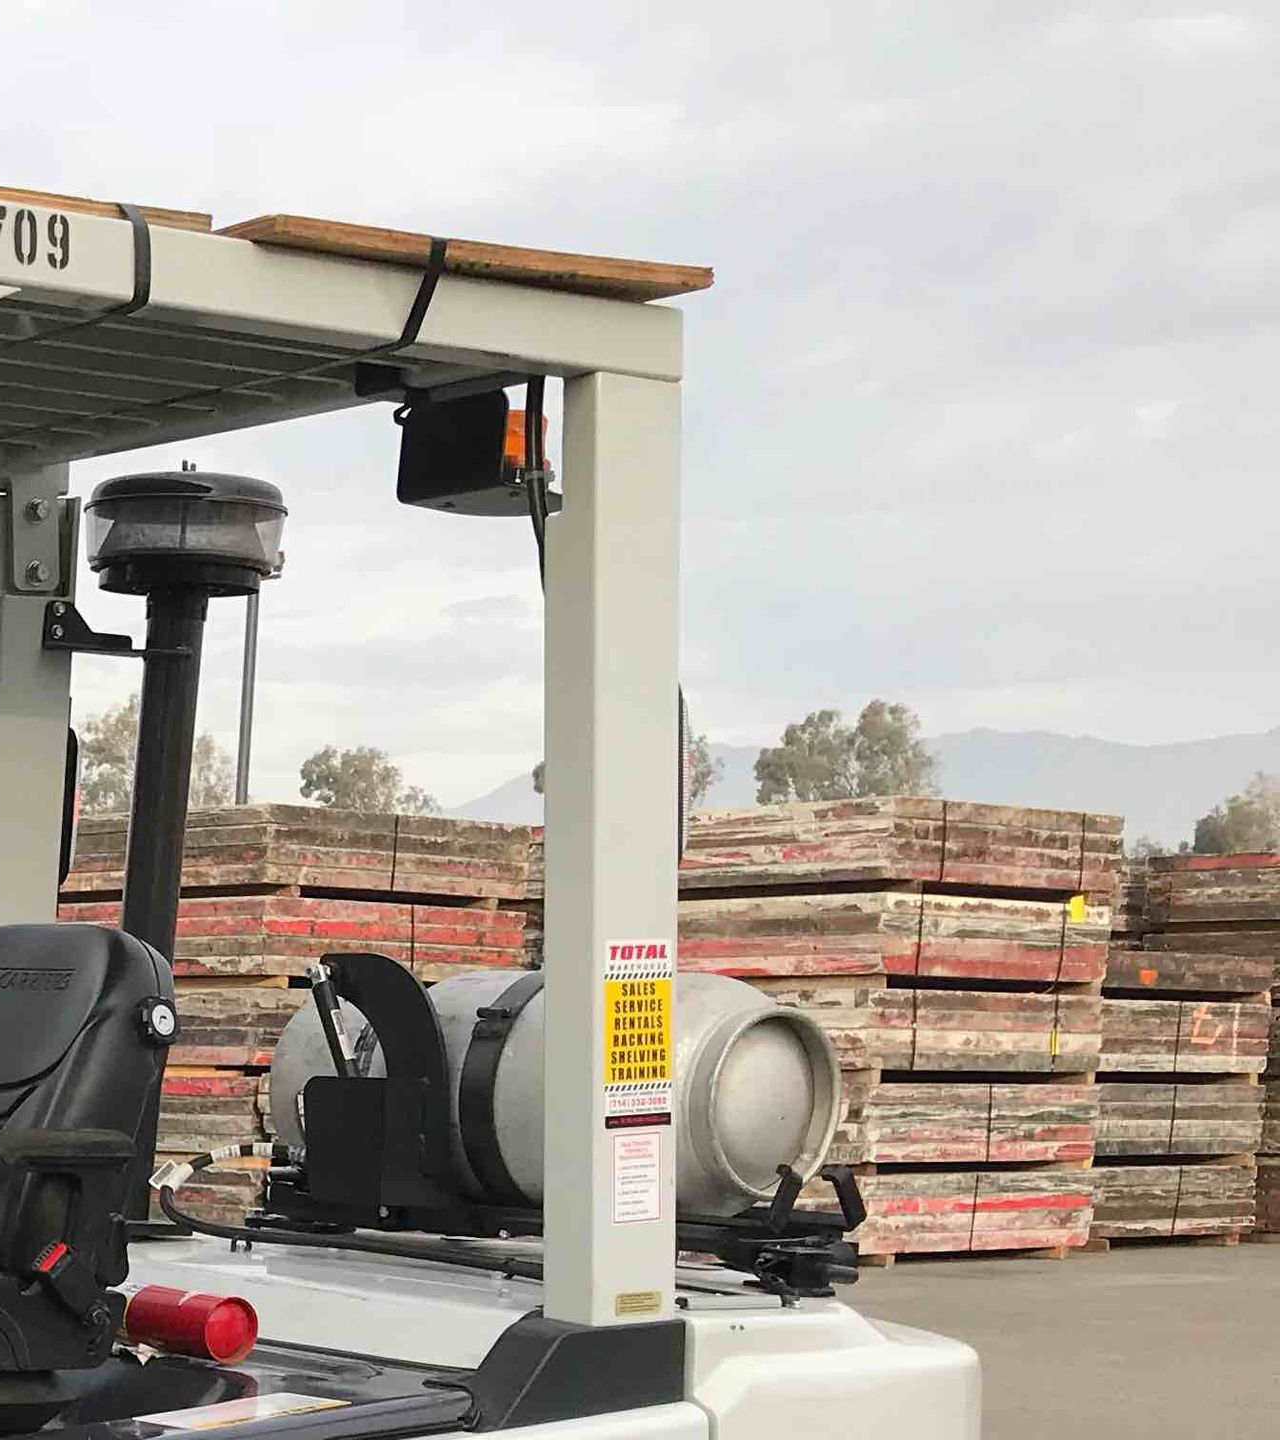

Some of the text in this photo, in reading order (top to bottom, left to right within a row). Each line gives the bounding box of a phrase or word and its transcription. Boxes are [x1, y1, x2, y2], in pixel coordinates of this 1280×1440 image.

[609, 944, 668, 961] TOTAL
[621, 982, 656, 996] SALES
[614, 999, 663, 1013] SERVICE
[614, 1015, 663, 1031] RENTALS
[611, 1048, 666, 1065] SHELVING
[611, 1065, 666, 1081] TRAINING
